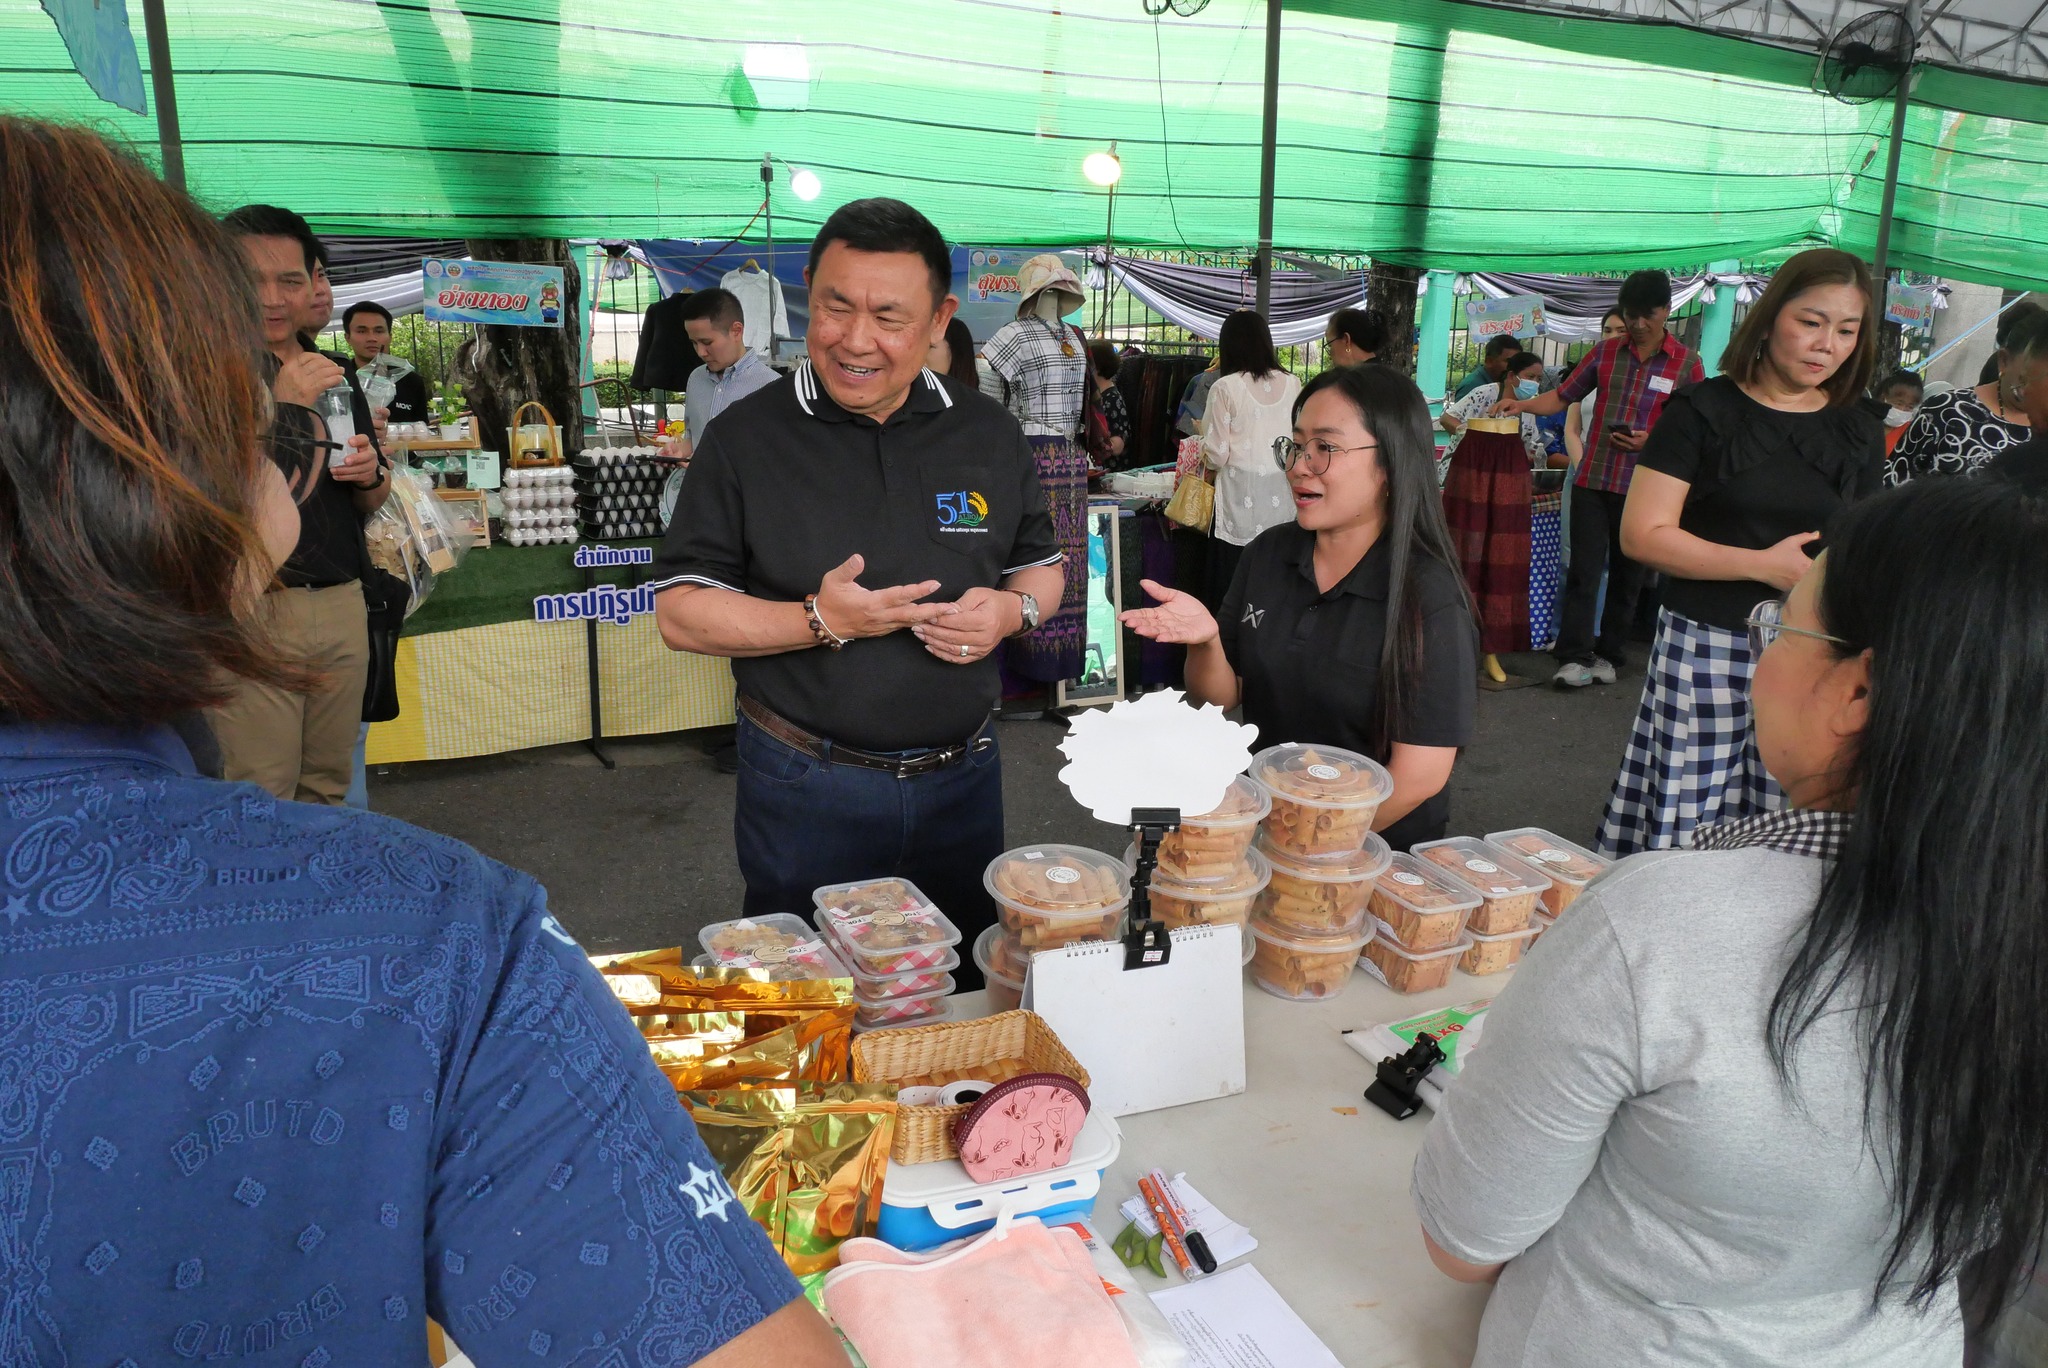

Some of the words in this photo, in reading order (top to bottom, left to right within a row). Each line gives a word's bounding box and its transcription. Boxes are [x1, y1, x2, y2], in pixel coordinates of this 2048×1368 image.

[438, 284, 529, 311] อ่างทอง
[978, 273, 1021, 299] สุพรร
[1479, 313, 1524, 336] สระบุรี
[936, 491, 972, 525] 51
[574, 545, 653, 567] สำนักงาน
[1180, 1214, 1191, 1227] PILOT
